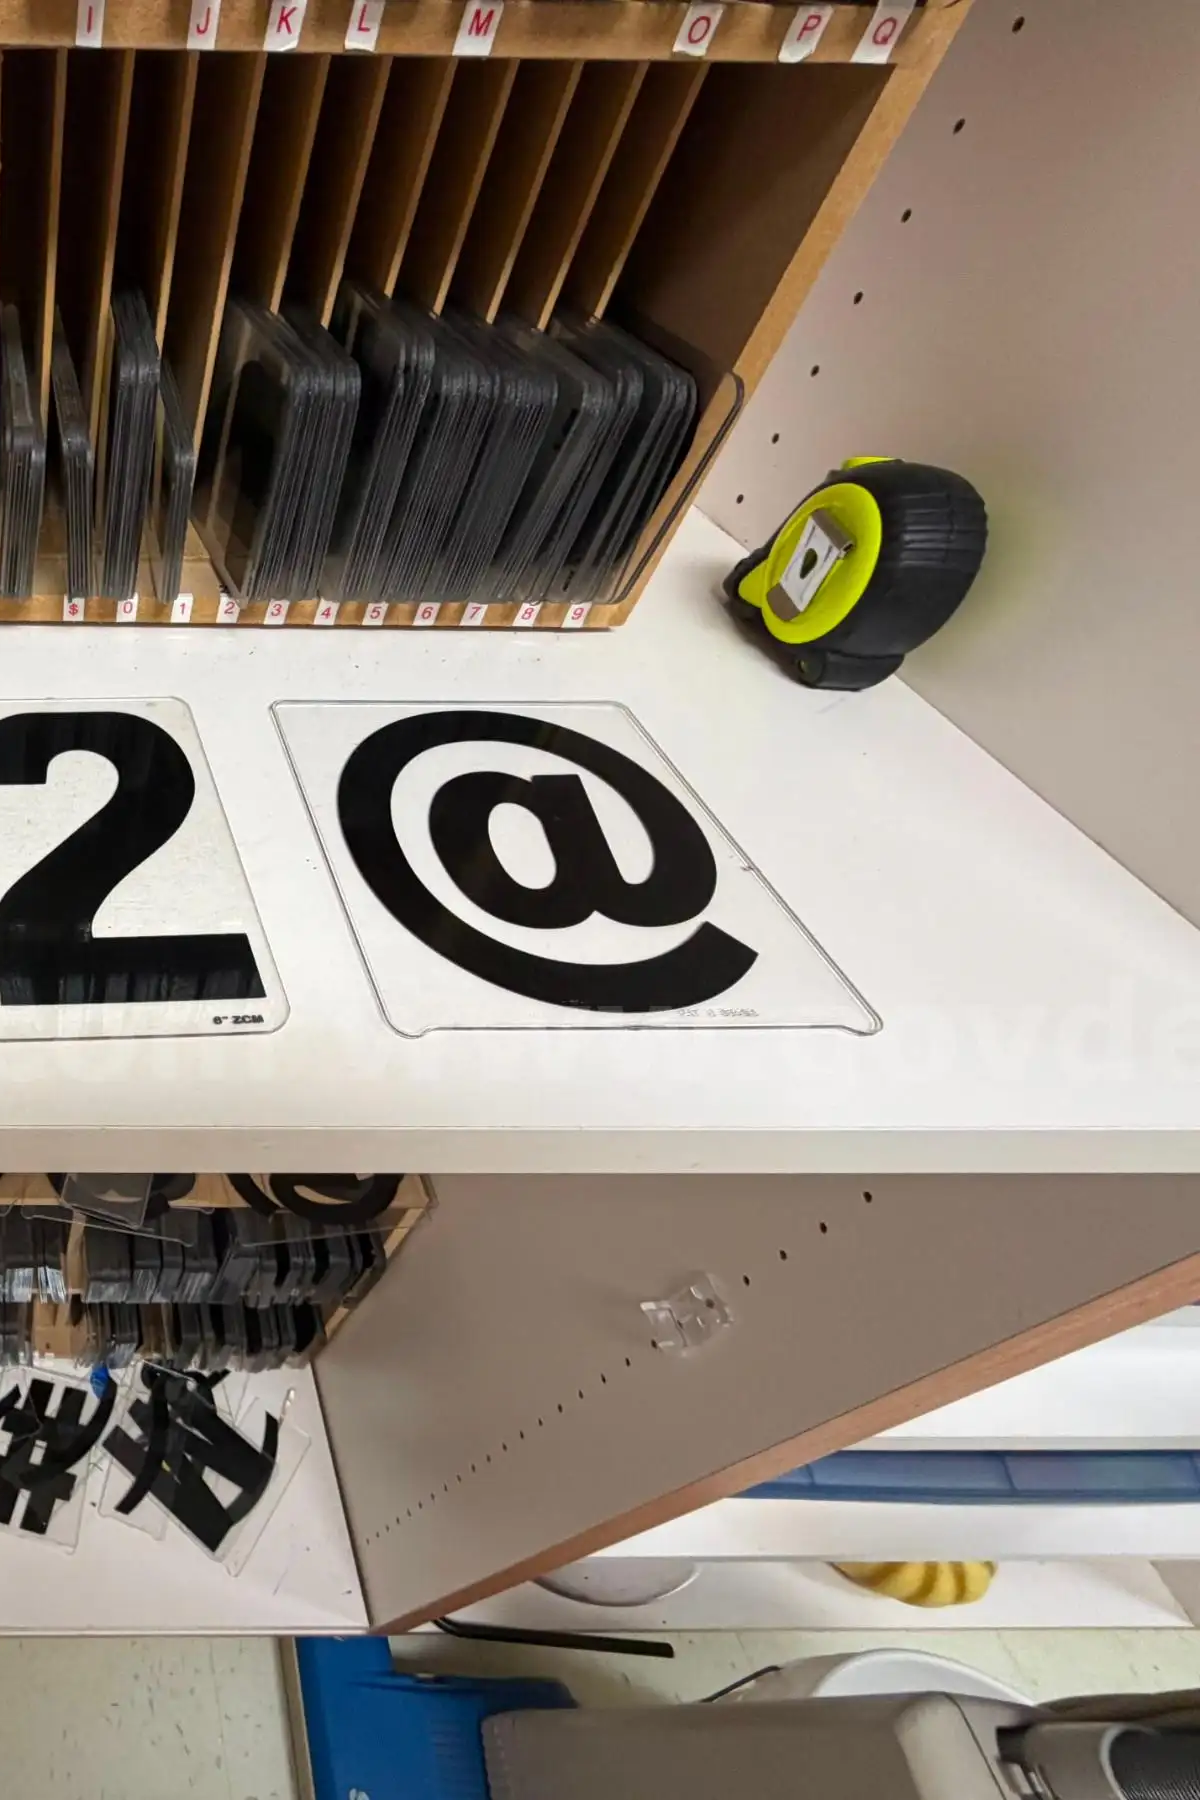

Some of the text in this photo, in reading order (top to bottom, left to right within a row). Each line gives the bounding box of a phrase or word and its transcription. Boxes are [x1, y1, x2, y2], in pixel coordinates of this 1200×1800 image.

[86, 7, 95, 33] I
[195, 10, 211, 35] J
[277, 8, 296, 35] K
[357, 7, 371, 33] L
[468, 8, 496, 36] M
[798, 14, 822, 41] P
[687, 15, 709, 45] O
[872, 16, 897, 46] Q
[68, 603, 79, 617] $
[224, 601, 236, 615] 2
[270, 603, 283, 617] 3
[320, 605, 332, 619] 4
[368, 605, 381, 620] 5
[420, 606, 434, 620] 6
[470, 606, 482, 620] 7
[520, 607, 534, 621] 8
[571, 607, 585, 621] 9
[337, 709, 759, 1014] @
[231, 1013, 265, 1025] ZCM
